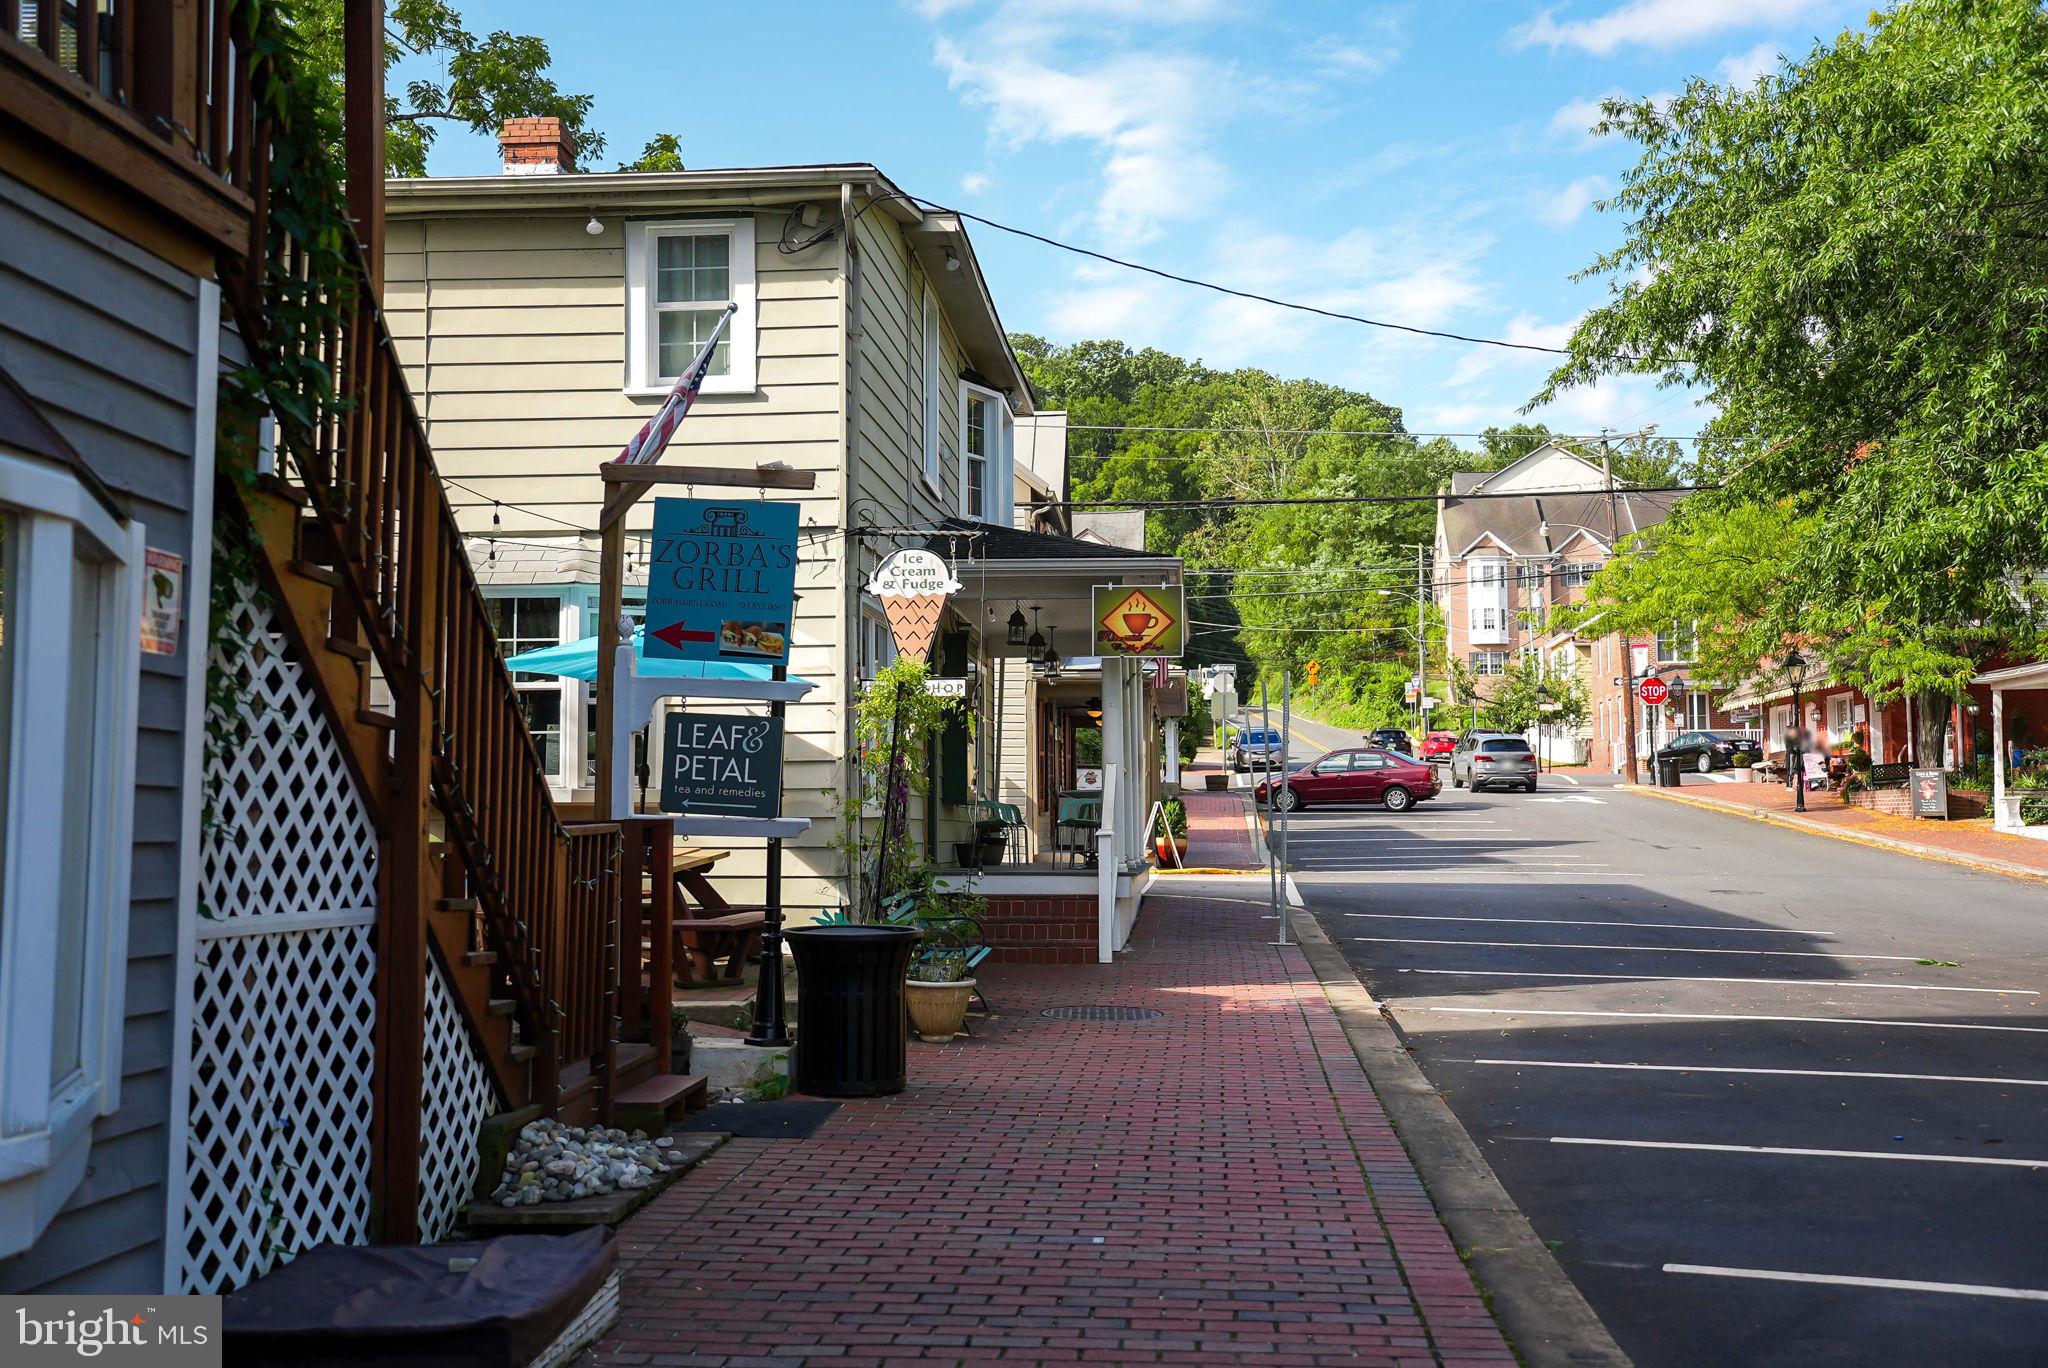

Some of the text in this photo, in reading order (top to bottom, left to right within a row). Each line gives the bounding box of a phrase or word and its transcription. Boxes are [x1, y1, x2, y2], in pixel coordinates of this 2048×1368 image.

[654, 539, 792, 569] ZORBA'S
[903, 553, 923, 564] Ice
[890, 566, 936, 577] Cream
[672, 566, 770, 594] GRILL
[882, 578, 944, 591] & Fudge
[927, 682, 963, 694] HOP
[1641, 685, 1665, 697] STOP
[674, 754, 757, 783] PETAL
[674, 785, 766, 798] tea and remedies
